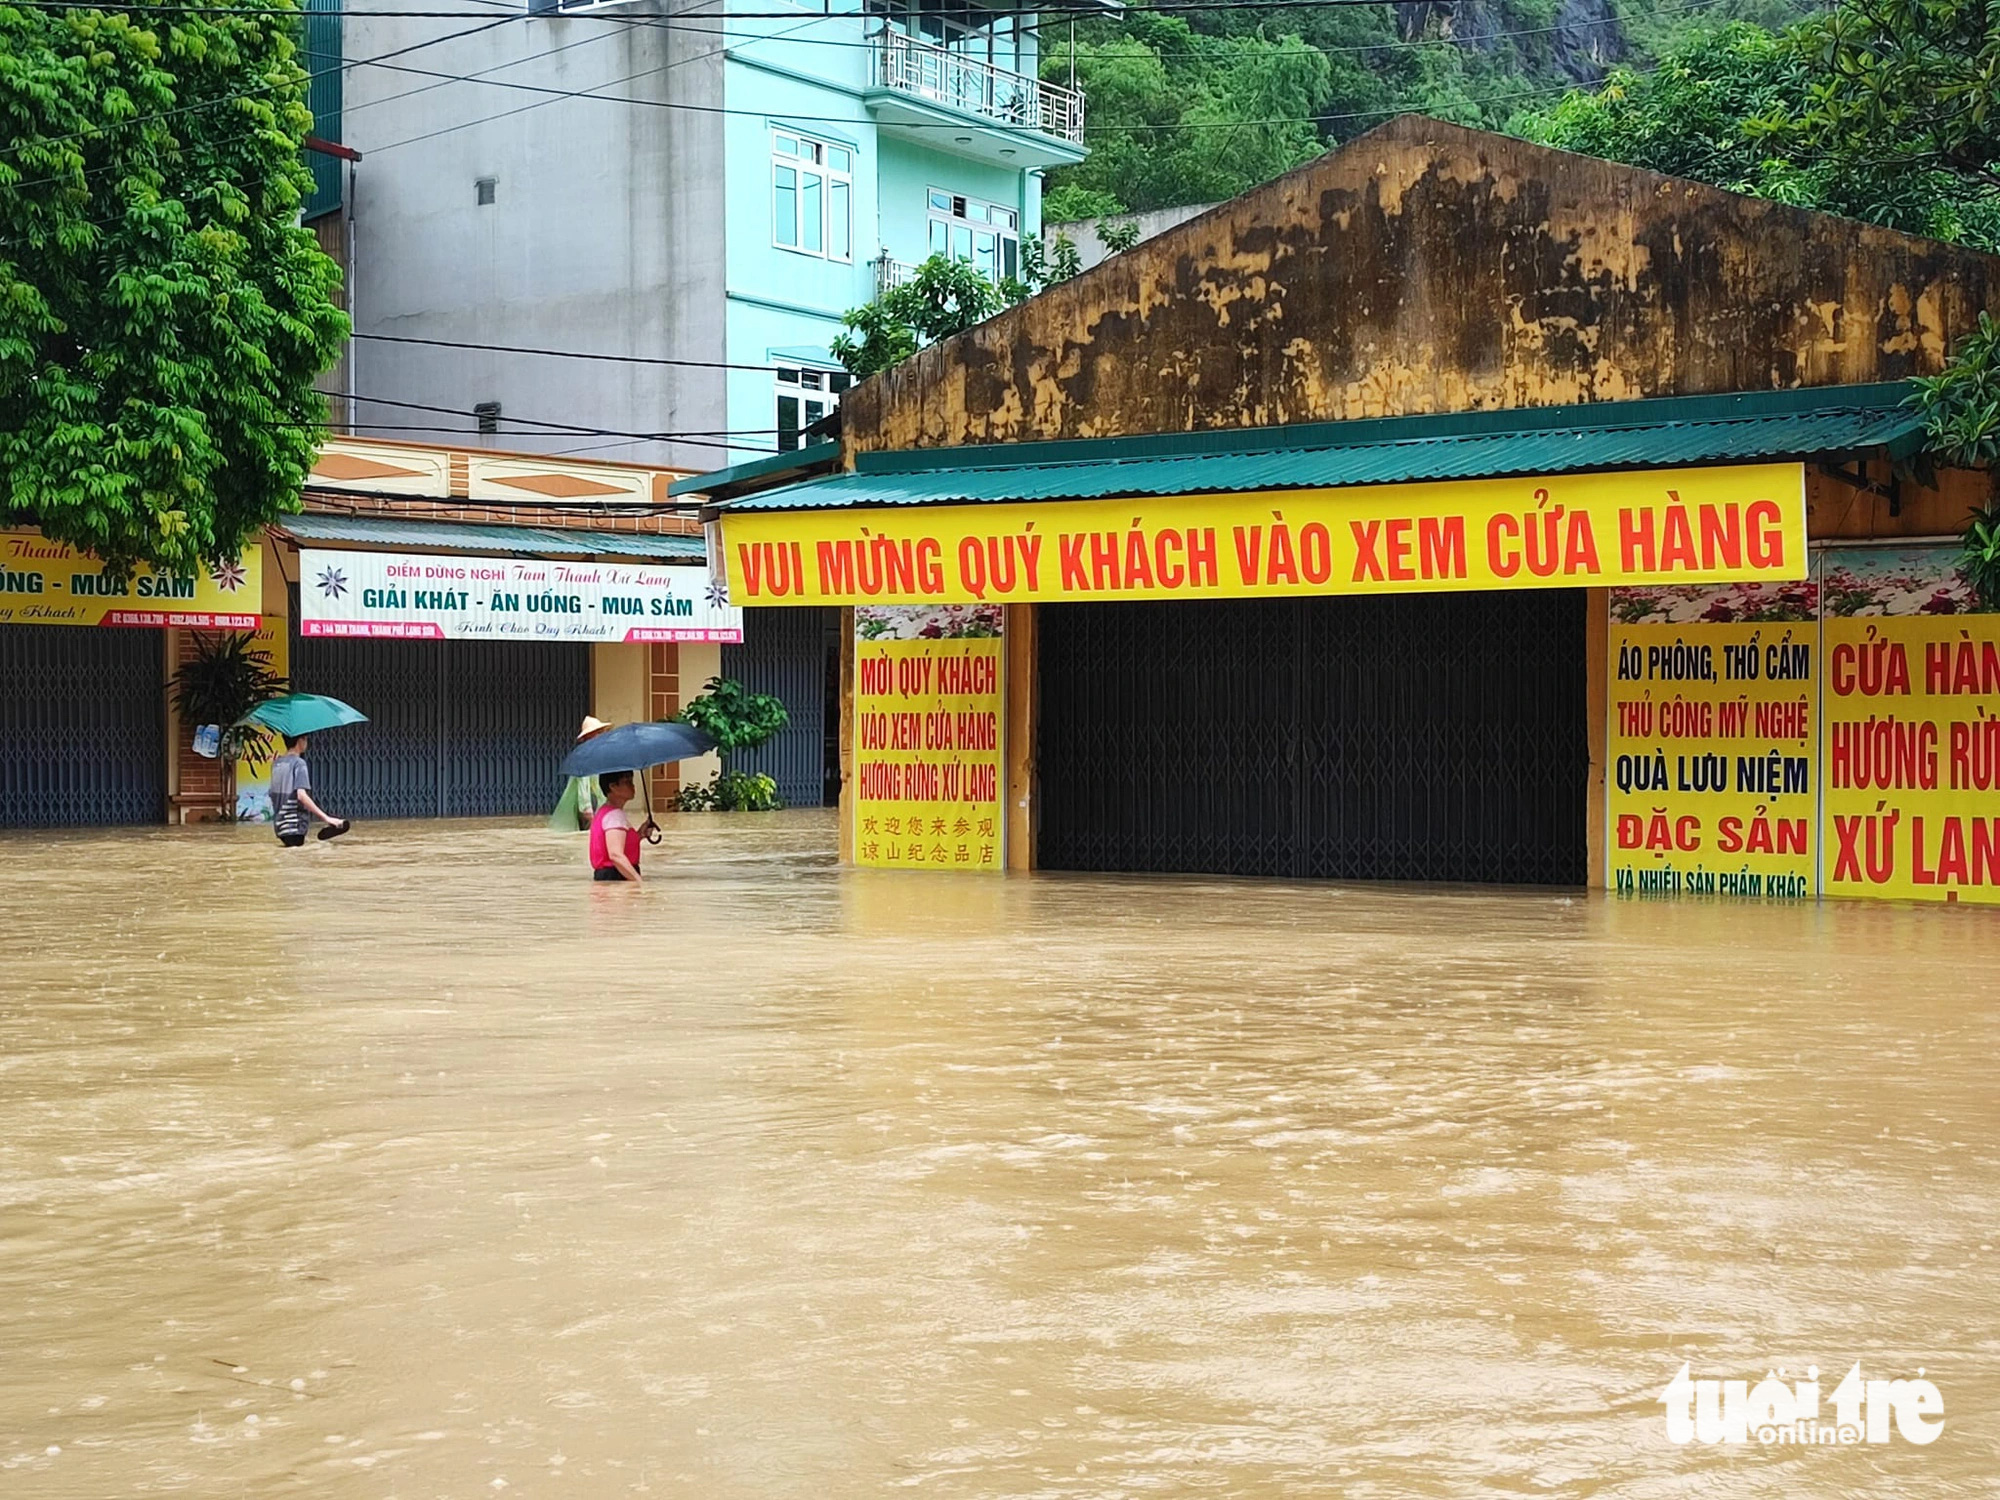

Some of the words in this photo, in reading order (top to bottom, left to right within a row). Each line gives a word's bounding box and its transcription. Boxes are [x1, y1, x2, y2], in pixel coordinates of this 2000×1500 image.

[738, 541, 804, 597] VUI
[816, 527, 944, 595] MỪNG
[958, 522, 1042, 600] QUÝ
[1059, 517, 1217, 592] KHÁCH
[1233, 511, 1332, 586] VÀO
[1349, 516, 1468, 583] XEM
[1487, 488, 1602, 578] CỬA
[1618, 490, 1784, 573] HÀNG
[387, 560, 421, 578] ĐIỂM
[425, 564, 466, 580] DỪNG
[512, 565, 546, 581] Tam
[553, 566, 601, 583] Thanh
[363, 583, 406, 608] GIẢI
[415, 587, 469, 611] KHÁT
[491, 589, 519, 612] ĂN
[527, 588, 581, 613] UỐNG
[602, 597, 644, 616] MUA
[650, 591, 693, 617] SẮM
[860, 648, 893, 696] MỜI
[899, 648, 932, 700] QUÝ
[937, 647, 997, 695] KHÁCH
[1617, 639, 1642, 681] ÁO
[1648, 638, 1718, 684] PHÔNG,
[1723, 630, 1761, 681] THỔ
[1766, 629, 1810, 680] CẨM
[1831, 624, 1912, 697] CỬA
[860, 704, 887, 750] VÀO
[891, 712, 922, 750] XEM
[925, 699, 953, 751] CỬA
[957, 703, 997, 750] HÀNG
[1617, 689, 1653, 738] THỦ
[1659, 693, 1712, 738] CÔNG
[1718, 694, 1749, 738] MỸ
[1755, 693, 1809, 747] NGHỆ
[1616, 748, 1669, 794] QUÀ
[1678, 752, 1727, 792] LƯU
[1736, 748, 1808, 801] NIỆM
[1831, 714, 1938, 791] HƯƠNG
[860, 759, 901, 801] HƯƠNG
[904, 755, 939, 801] RỪNG
[942, 754, 961, 802] XỨ
[963, 763, 997, 811] LẠNG
[861, 841, 995, 864] 谅山纪念品店
[862, 815, 996, 838] 欢迎您来参观
[1616, 806, 1701, 858] ĐẶC
[1717, 805, 1808, 855] SẢN
[1832, 800, 1900, 884] XỨ
[1616, 864, 1634, 891] VÀ
[1686, 864, 1715, 893] SẢN
[1719, 863, 1762, 895] PHẨM
[1766, 870, 1807, 897] KHÁC
